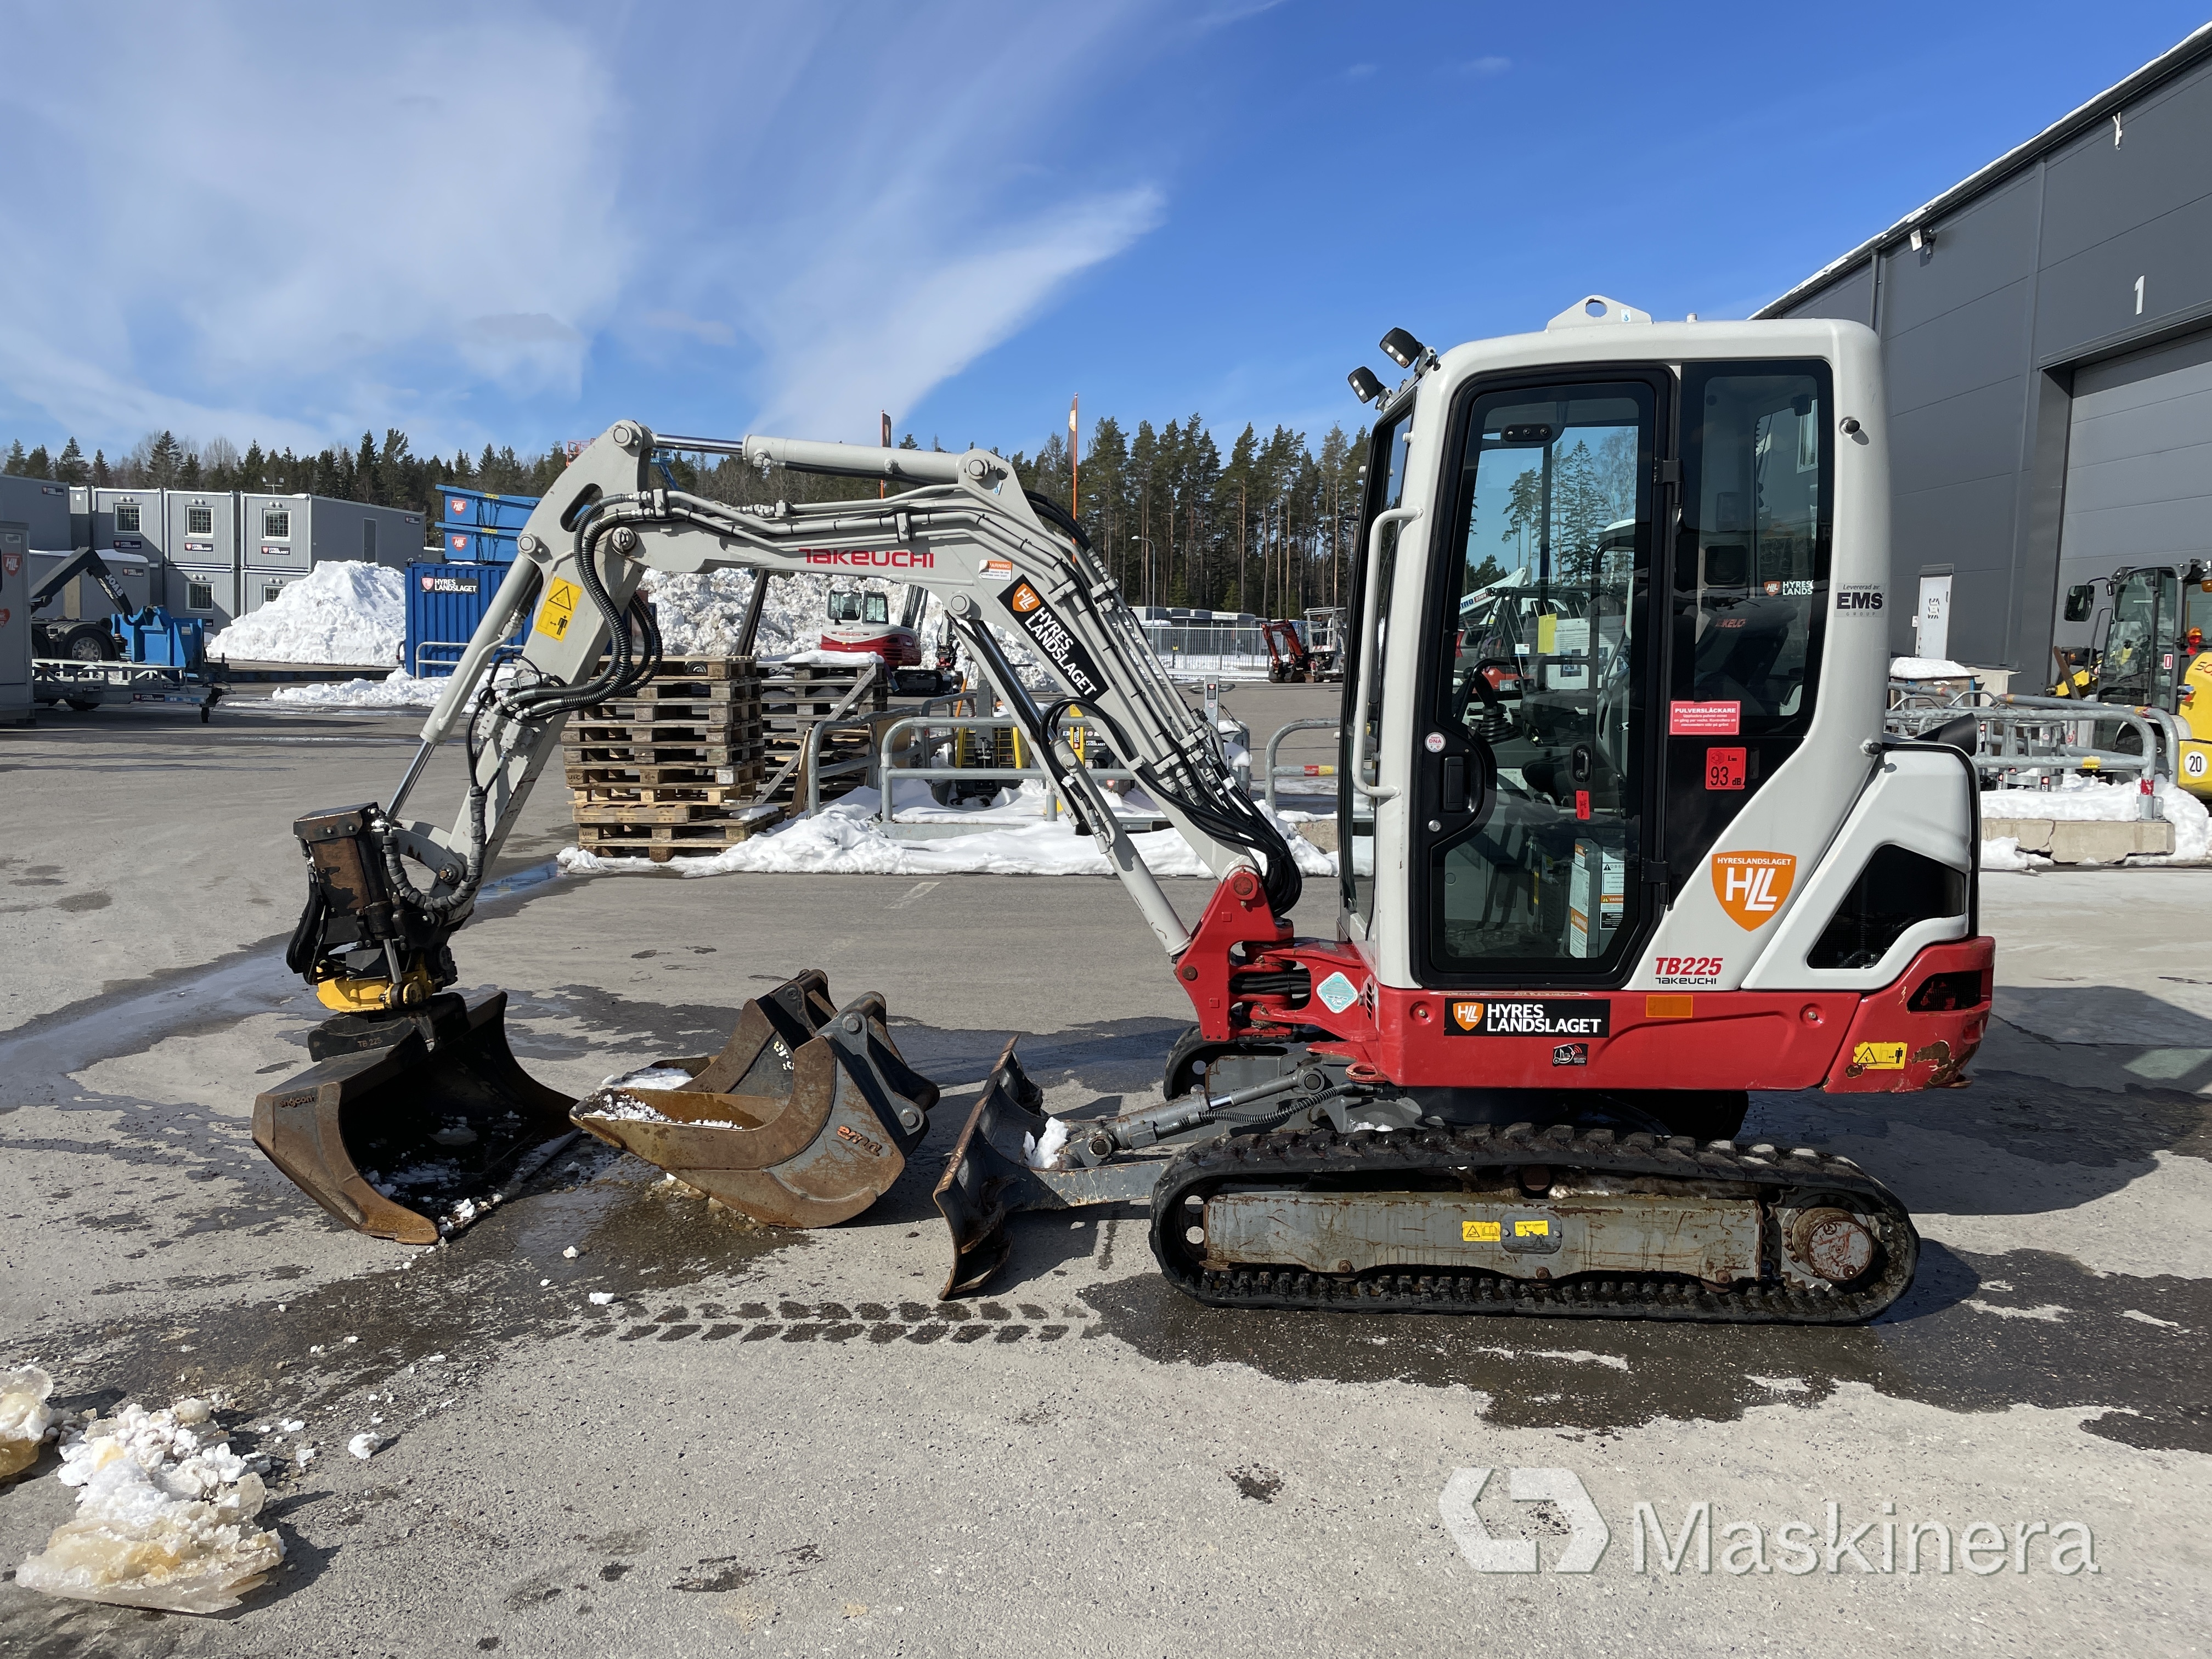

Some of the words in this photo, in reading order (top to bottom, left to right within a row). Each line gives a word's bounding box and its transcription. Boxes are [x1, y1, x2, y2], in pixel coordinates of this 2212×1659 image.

[2134, 275, 2145, 315] 1
[105, 574, 123, 596] JOAB
[1836, 592, 1883, 610] EMS
[1034, 606, 1074, 651] HYRES
[1024, 615, 1097, 696] LANDSLAGET
[2189, 756, 2202, 772] 20
[1710, 766, 1729, 786] 93
[1732, 777, 1741, 786] dB
[1717, 857, 1792, 866] HYRESLANDSLAGET
[1655, 957, 1723, 975] TB225
[1487, 1003, 1544, 1018] HYRES
[1487, 1018, 1601, 1033] LANDSLAGET
[369, 1037, 382, 1046] 225
